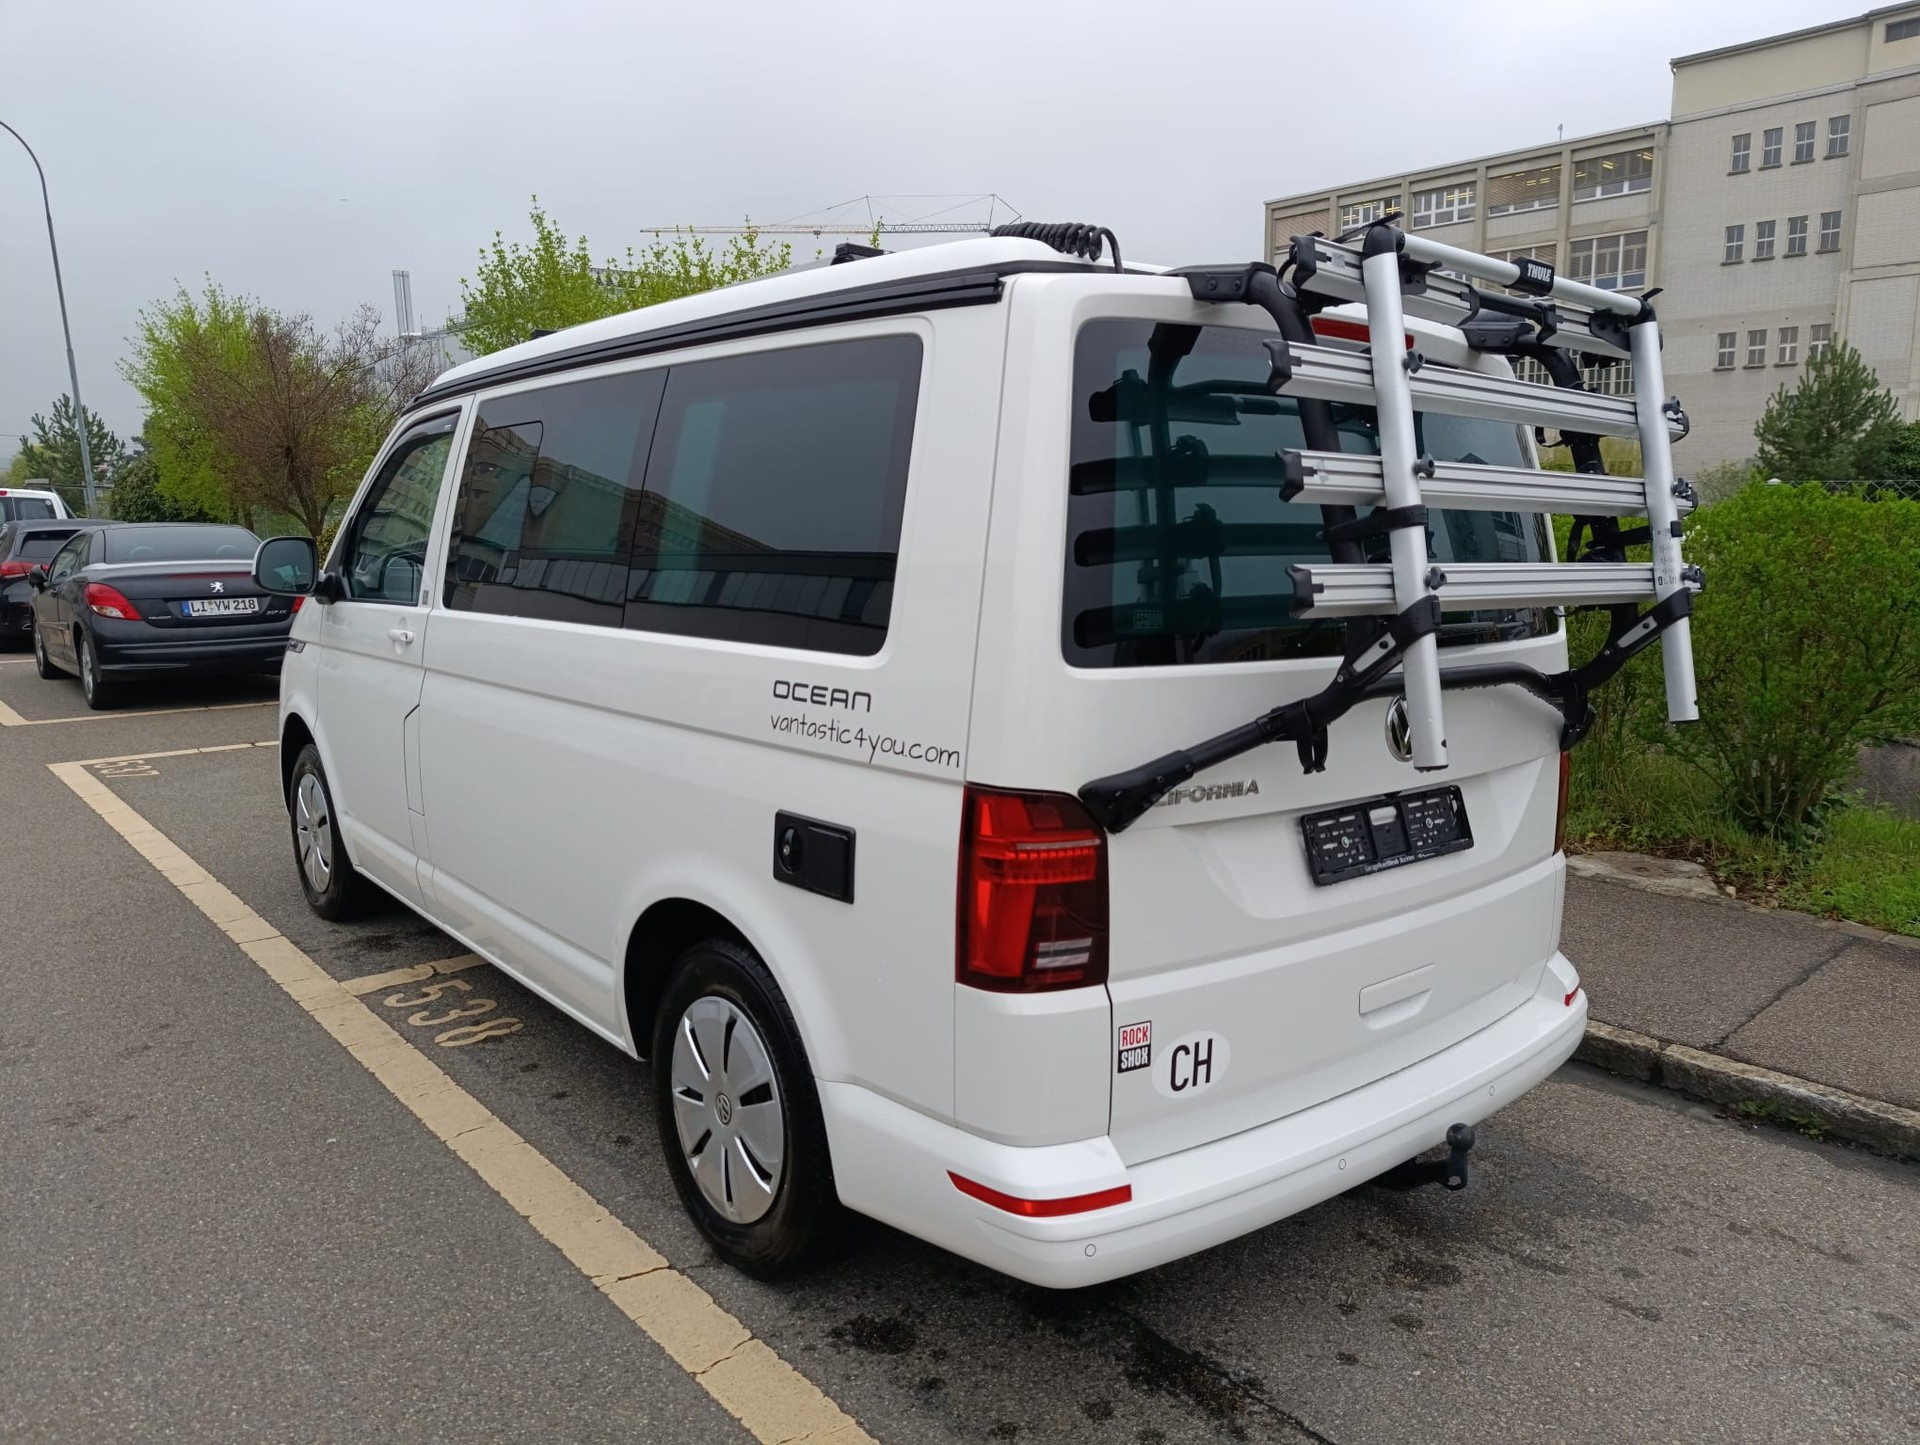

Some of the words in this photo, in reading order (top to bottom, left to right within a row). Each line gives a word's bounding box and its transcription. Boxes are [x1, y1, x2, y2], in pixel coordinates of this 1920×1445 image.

[1527, 263, 1552, 282] THULE
[191, 601, 209, 613] LI
[215, 600, 231, 611] YW
[233, 599, 256, 610] 218
[773, 679, 872, 713] OCEAN
[770, 713, 961, 769] vantastic4you.com
[1122, 1026, 1149, 1047] ROCK
[1121, 1046, 1149, 1069] SHOX
[1171, 1038, 1213, 1092] CH
